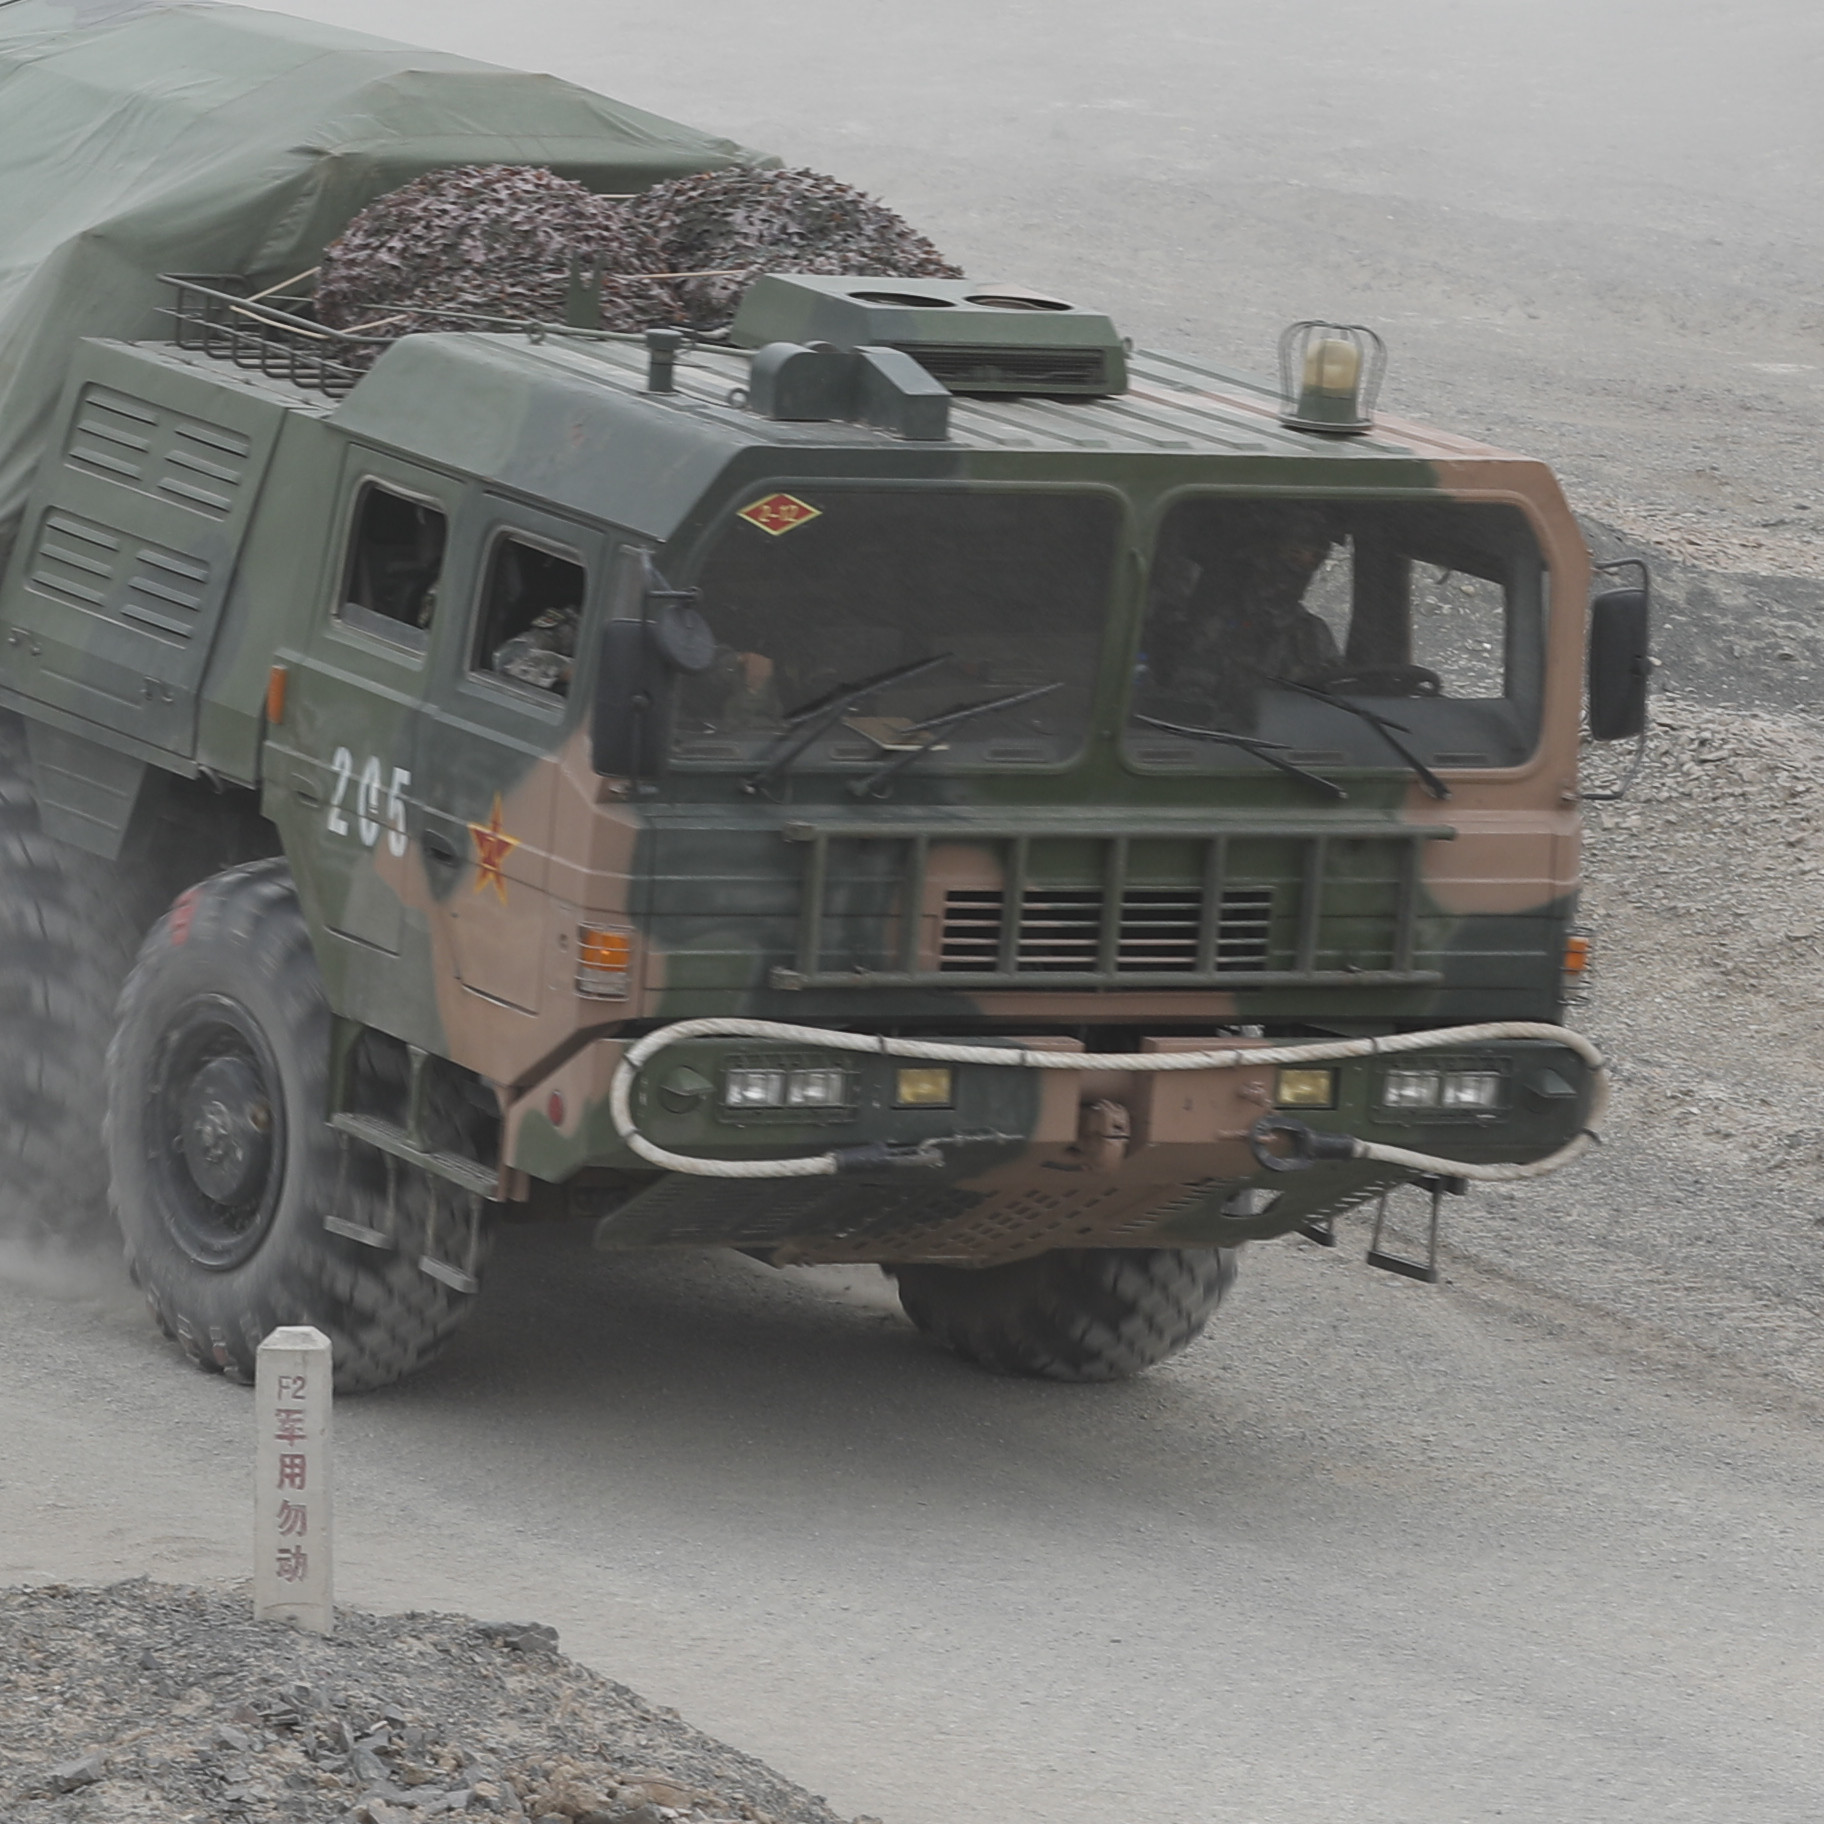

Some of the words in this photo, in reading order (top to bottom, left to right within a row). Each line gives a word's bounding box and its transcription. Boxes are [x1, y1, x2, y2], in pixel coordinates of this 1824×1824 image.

[327, 745, 411, 858] 205
[278, 1375, 306, 1401] F2
[274, 1408, 309, 1583] 军用勿动
